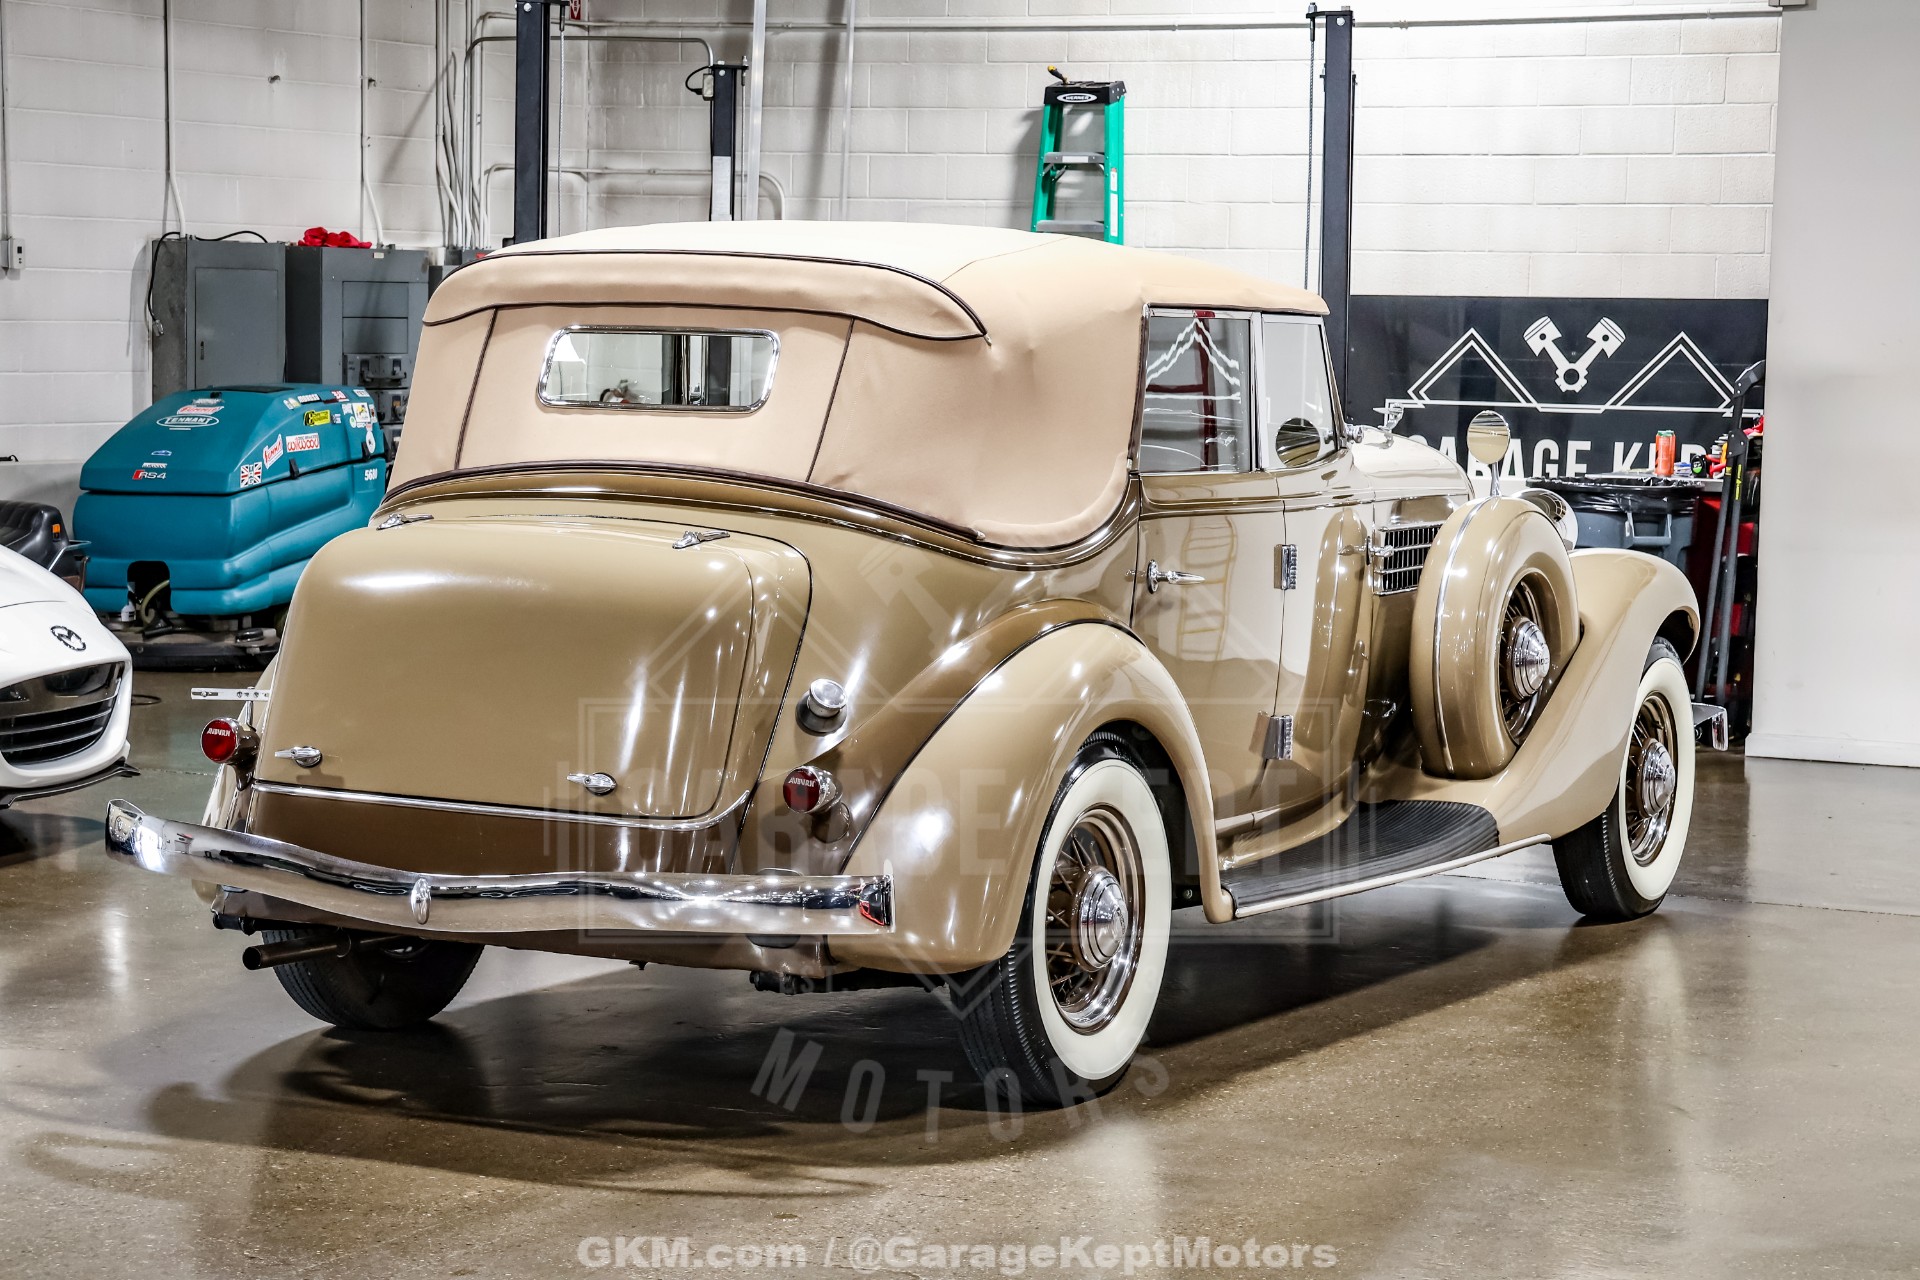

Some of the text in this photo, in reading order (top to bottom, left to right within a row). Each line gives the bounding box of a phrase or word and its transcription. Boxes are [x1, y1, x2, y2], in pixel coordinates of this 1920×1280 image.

[165, 417, 213, 425] TENNANT
[139, 471, 166, 480] RS4
[788, 777, 816, 788] AUBURN
